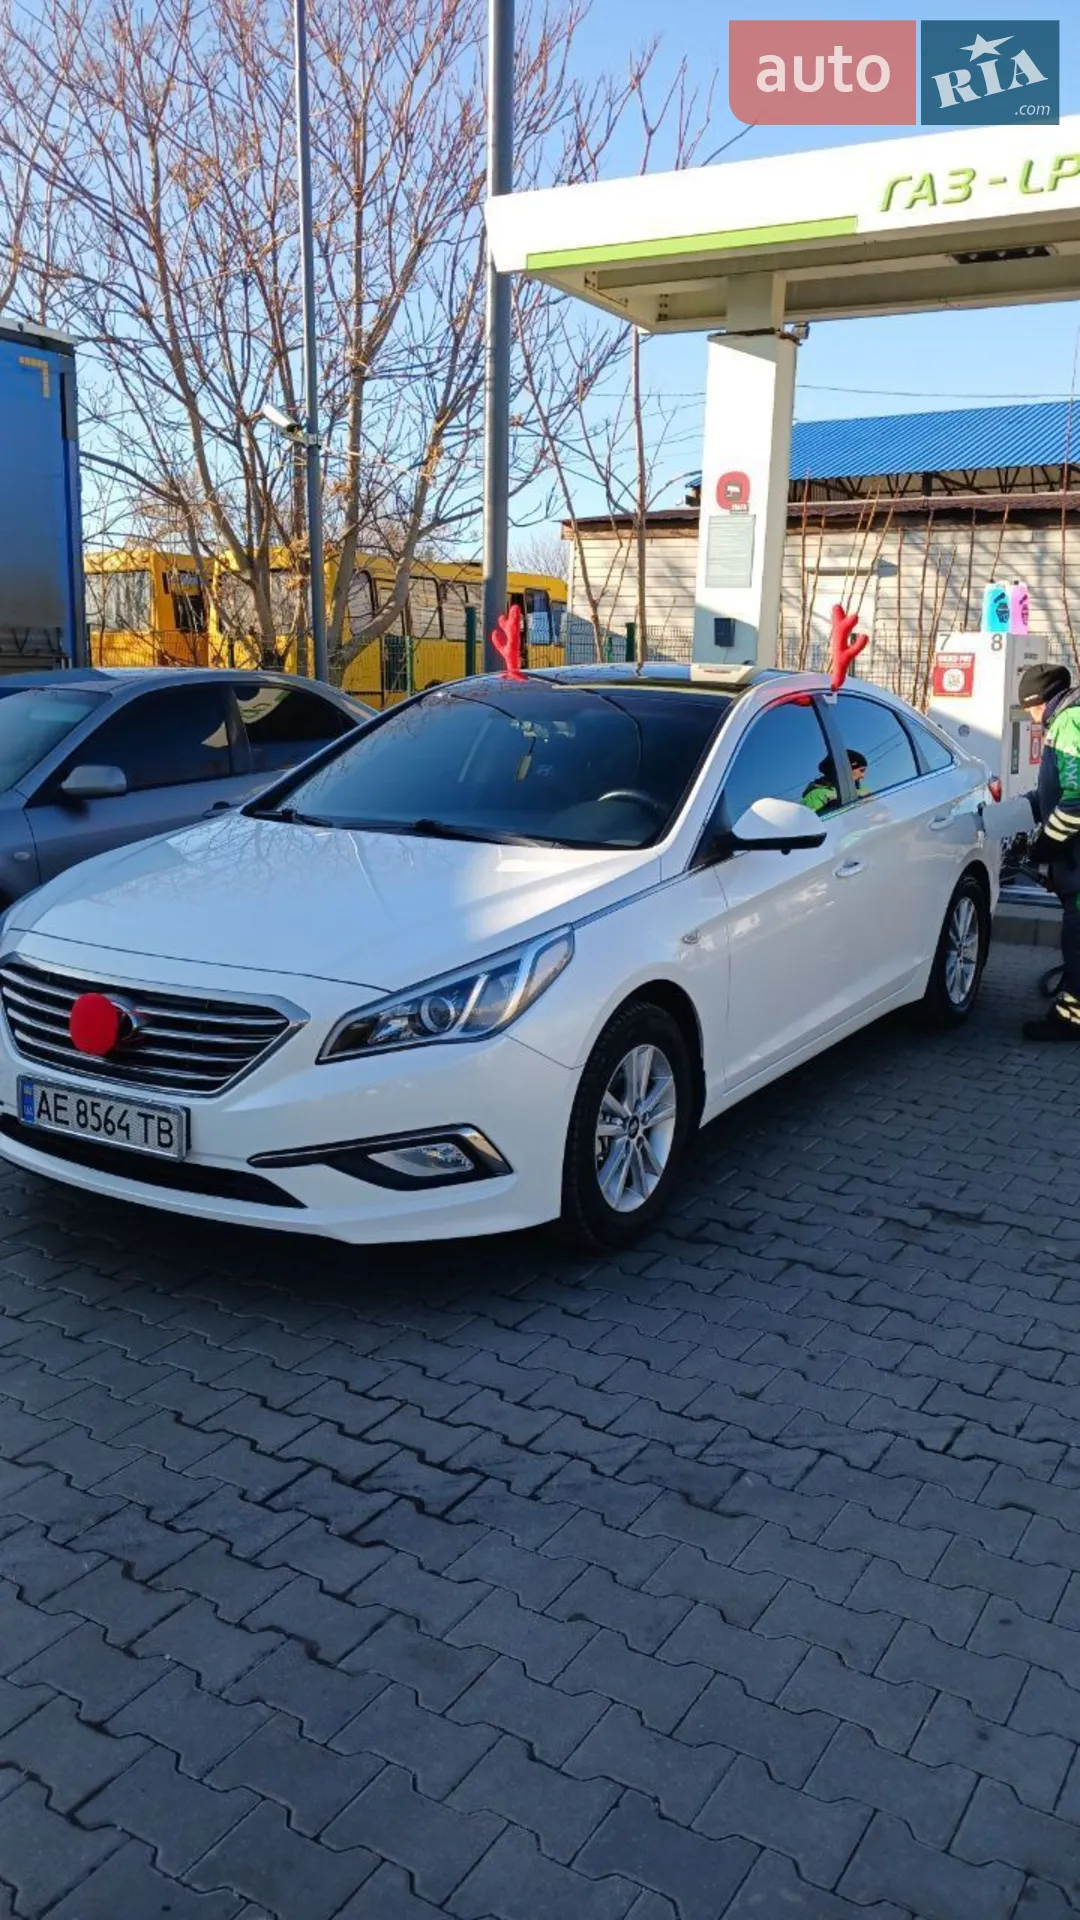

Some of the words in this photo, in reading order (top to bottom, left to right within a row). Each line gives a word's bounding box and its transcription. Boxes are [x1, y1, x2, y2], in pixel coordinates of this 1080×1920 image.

[879, 168, 976, 212] ГАЗ
[939, 633, 951, 650] 7
[991, 633, 1003, 651] 8
[37, 1090, 69, 1125] AE
[76, 1099, 130, 1140] 8564
[137, 1112, 174, 1148] TB
